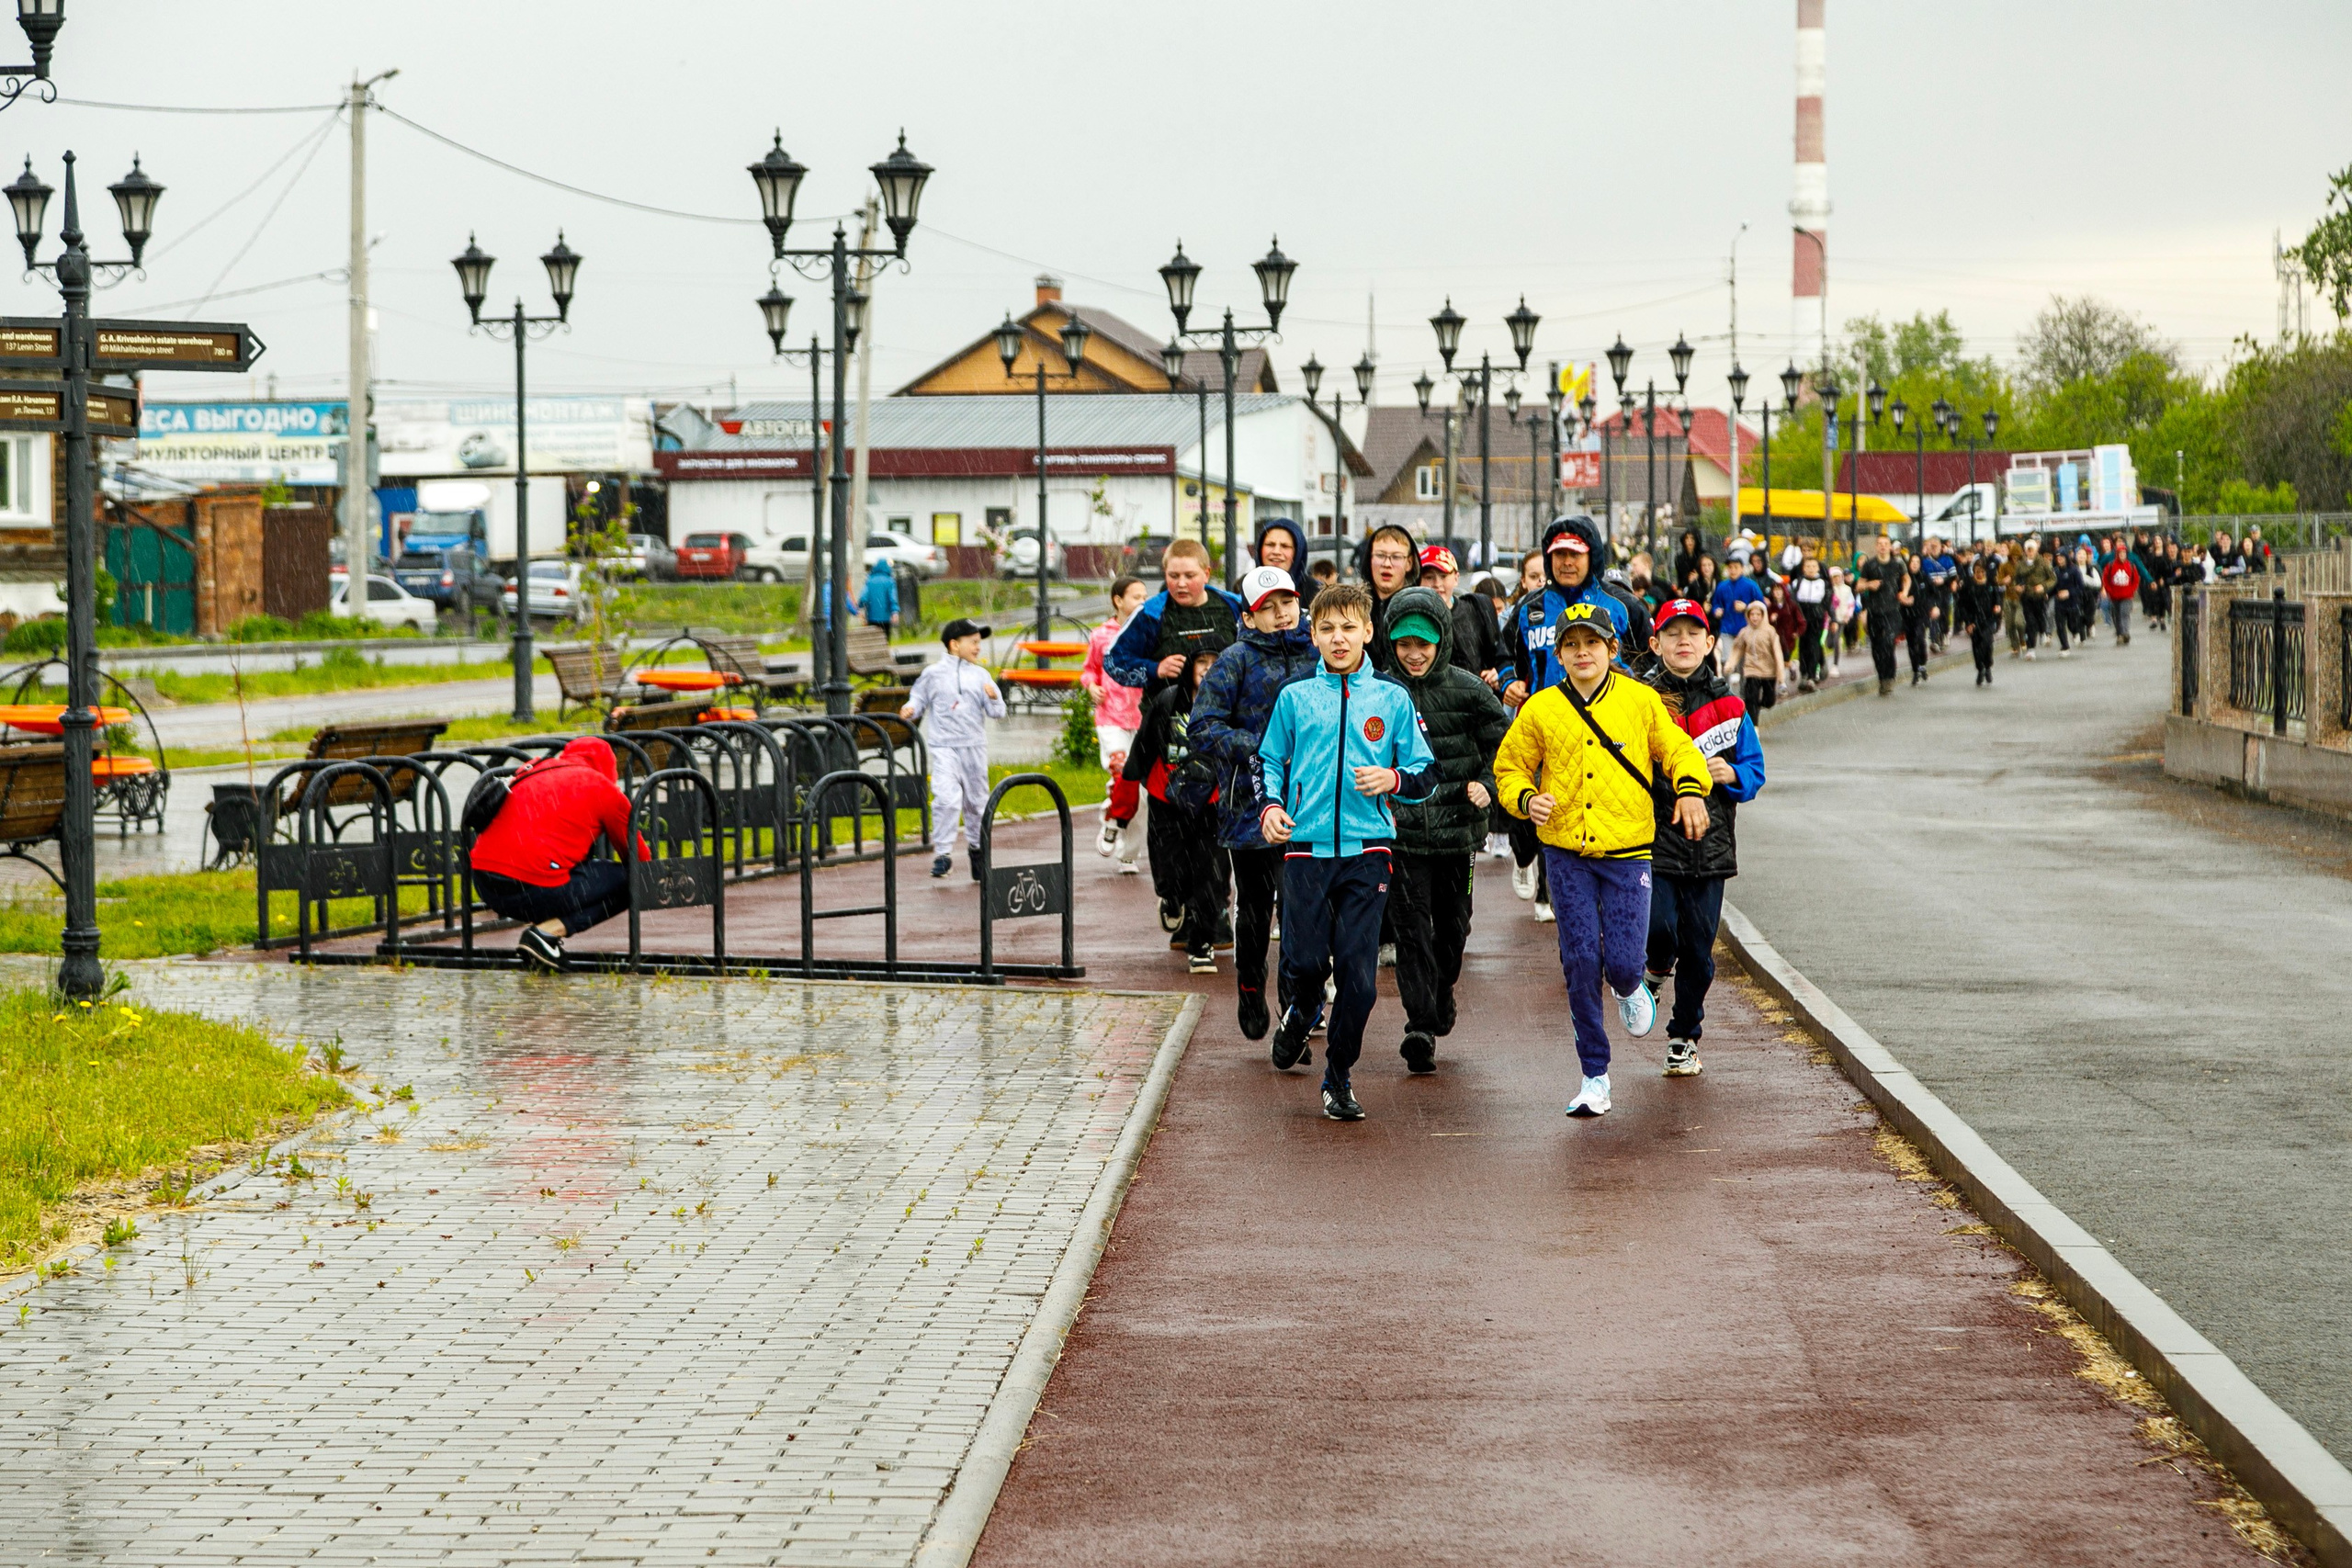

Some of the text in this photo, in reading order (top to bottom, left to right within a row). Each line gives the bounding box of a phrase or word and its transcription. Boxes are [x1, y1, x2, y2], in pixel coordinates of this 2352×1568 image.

[2, 332, 52, 341] and warehouses
[100, 333, 213, 345] G. A. Krivoshein's estate warehouse
[6, 342, 52, 352] 137 Lenin Street
[100, 344, 175, 355] 69 Mikhailovskaya street
[194, 407, 317, 433] ВЫГОДНО
[266, 445, 323, 462] ЦЕНТР
[1565, 603, 1597, 621] W
